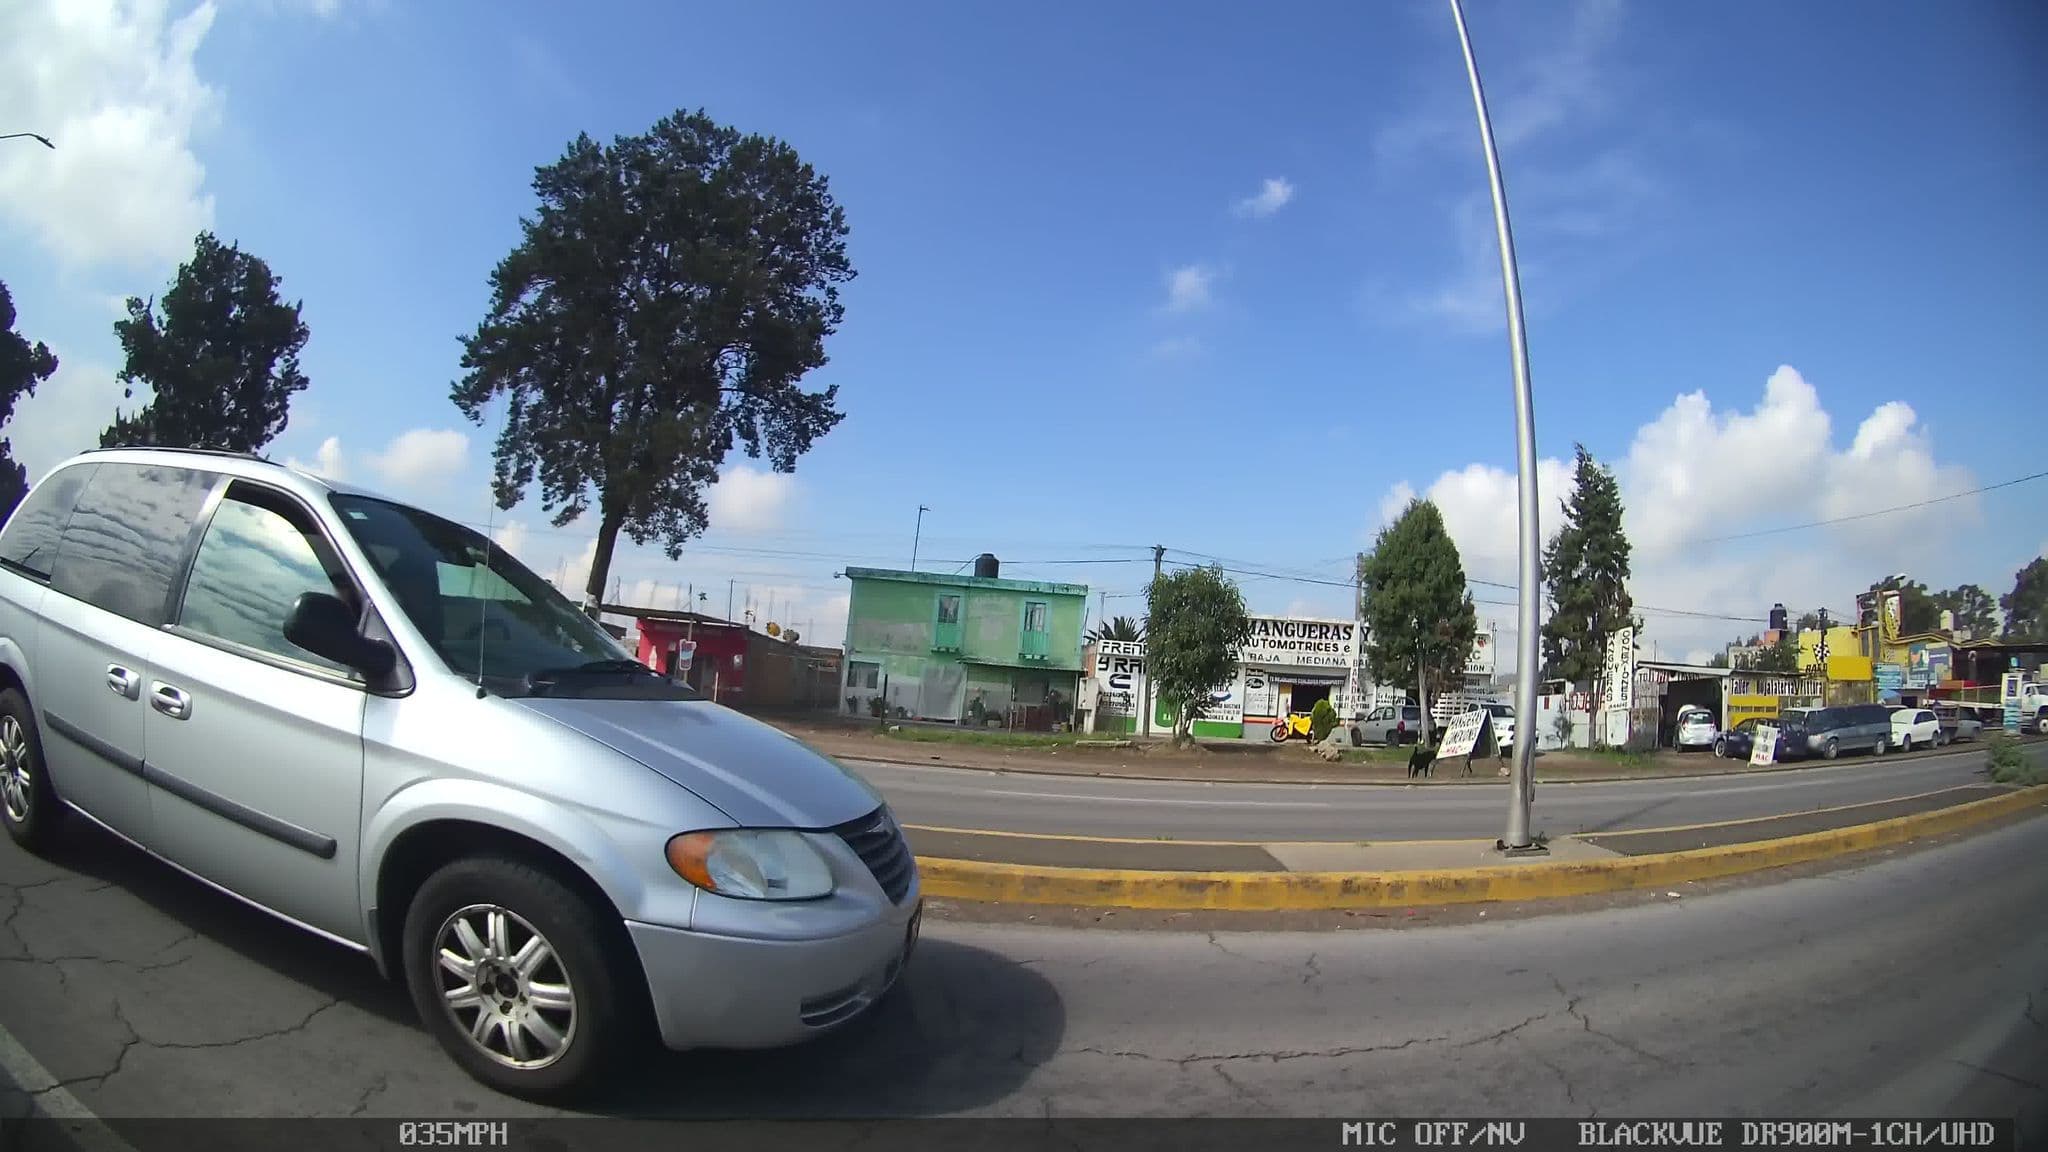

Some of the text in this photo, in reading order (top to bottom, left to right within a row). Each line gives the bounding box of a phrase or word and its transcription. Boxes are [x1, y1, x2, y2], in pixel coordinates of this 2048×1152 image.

[1296, 656, 1347, 666] MEDIANA
[1606, 631, 1616, 702] MANGUERAS
[1621, 630, 1631, 701] CONEXIONES
